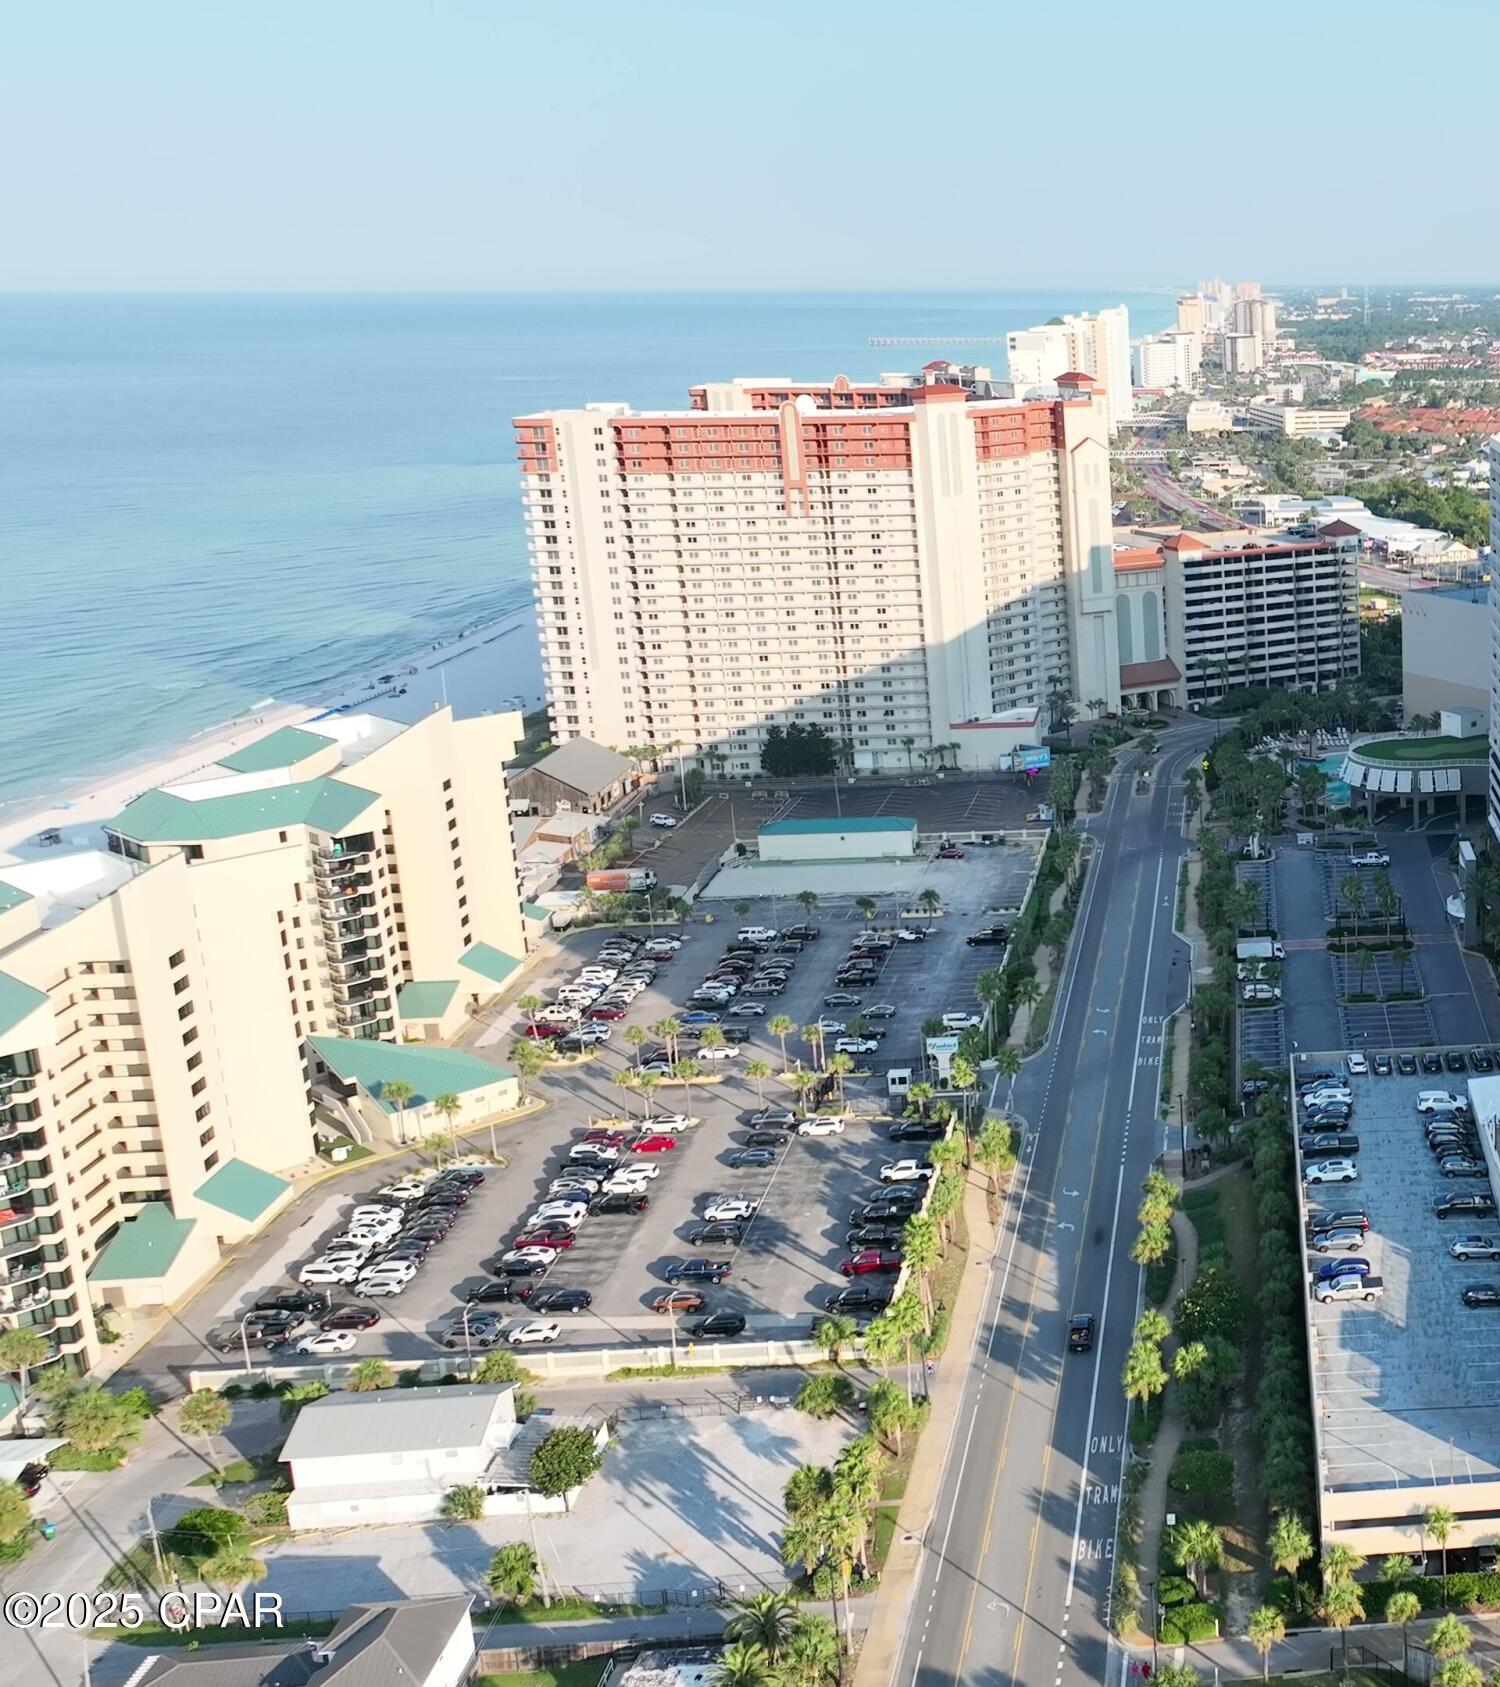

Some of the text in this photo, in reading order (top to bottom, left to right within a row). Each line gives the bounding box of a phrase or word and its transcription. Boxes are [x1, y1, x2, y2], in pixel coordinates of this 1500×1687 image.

[1142, 1015, 1164, 1024] ONLY
[1141, 1035, 1162, 1044] TRAM
[1137, 1056, 1160, 1066] BIKE
[1090, 1435, 1124, 1454] ONLY
[1086, 1484, 1119, 1505] TRAM
[1078, 1538, 1113, 1561] BIKE
